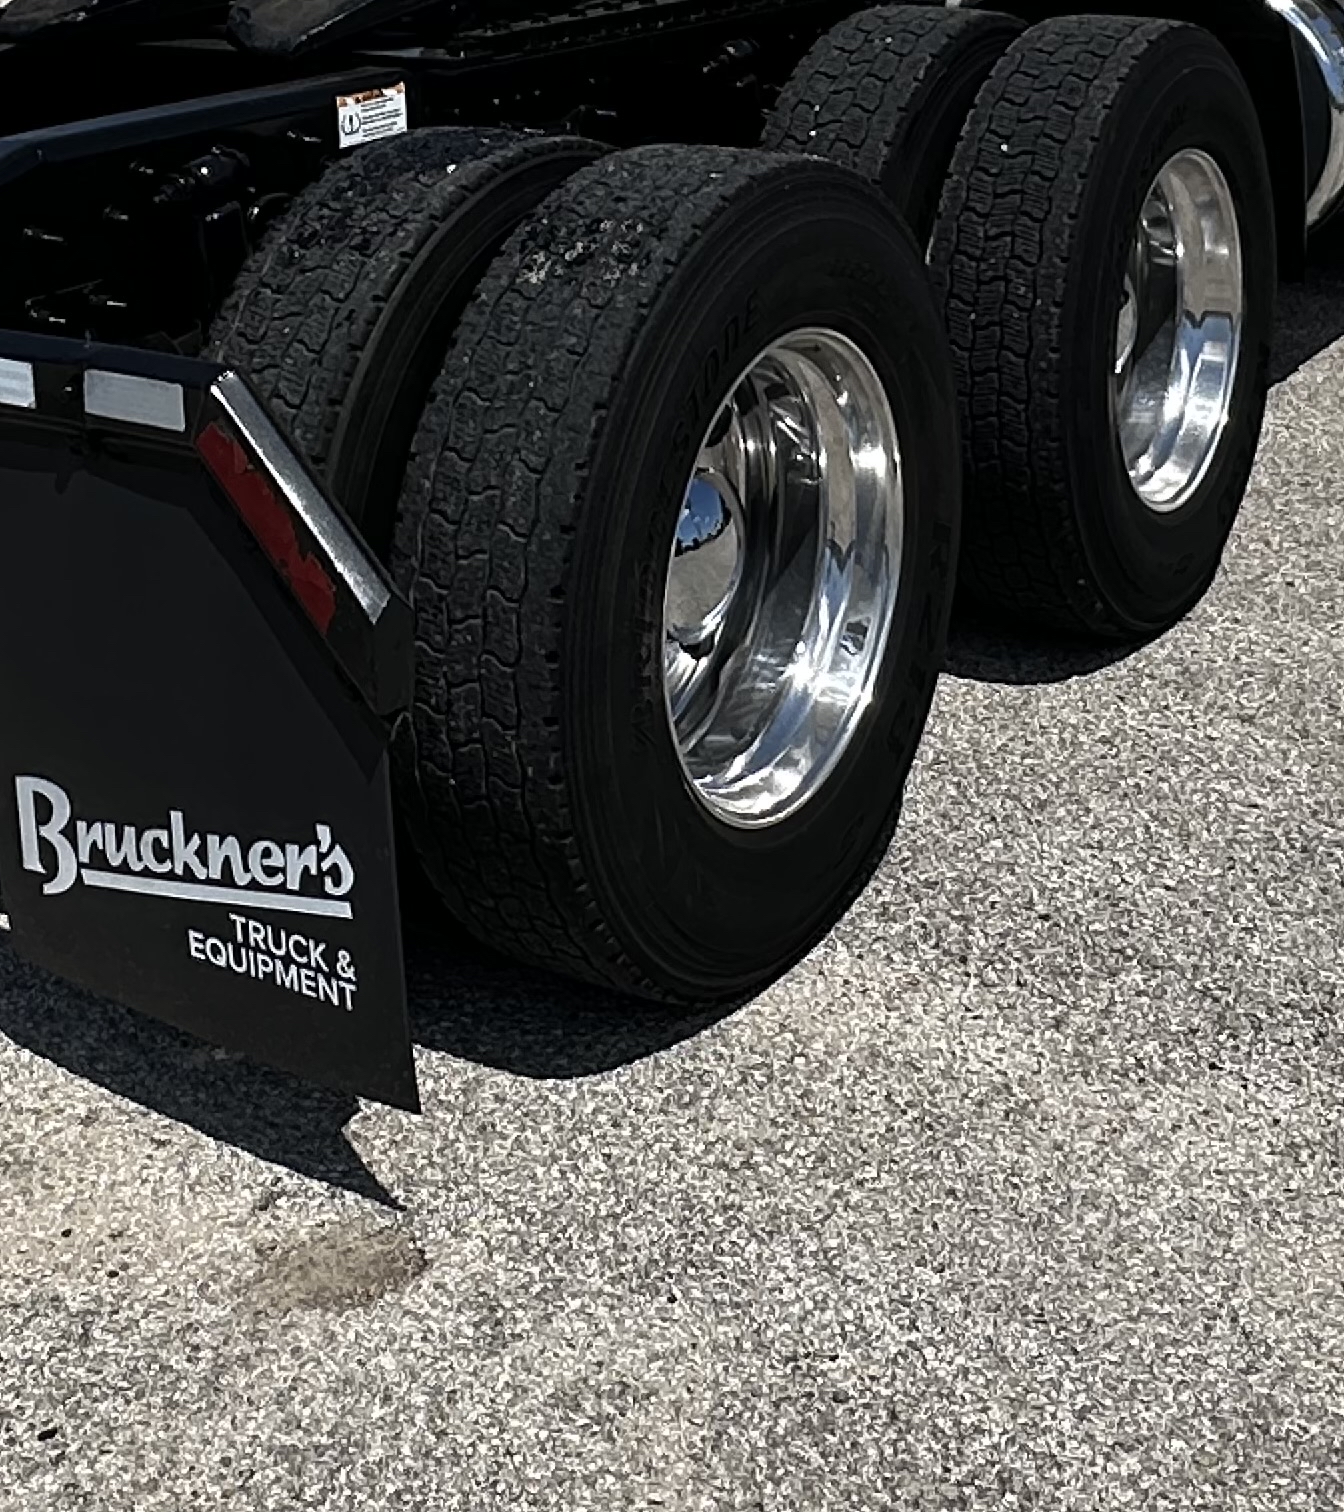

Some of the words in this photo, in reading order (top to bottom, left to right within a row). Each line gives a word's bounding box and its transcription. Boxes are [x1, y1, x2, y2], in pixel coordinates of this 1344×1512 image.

[15, 776, 354, 896] Bruckner's
[188, 928, 357, 1011] EQUIPMENT
[228, 912, 328, 973] TRUCK
[336, 949, 357, 982] &
